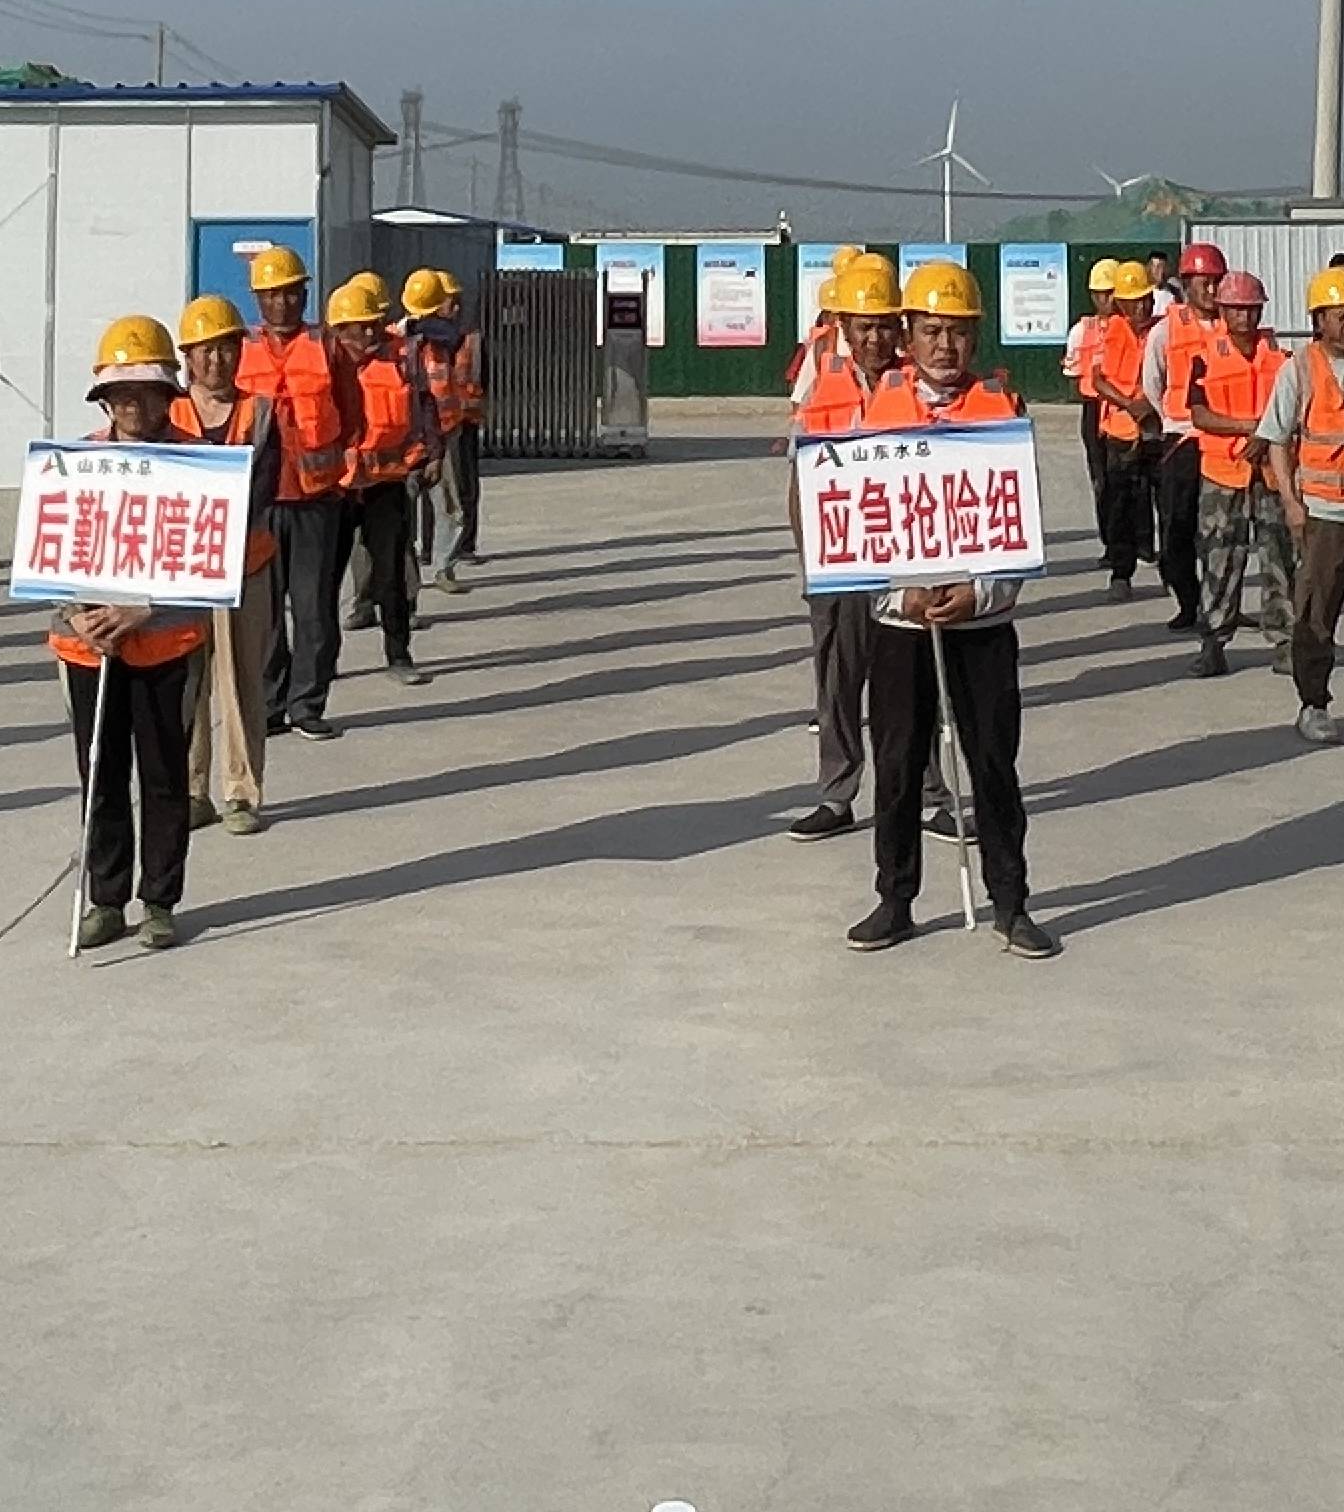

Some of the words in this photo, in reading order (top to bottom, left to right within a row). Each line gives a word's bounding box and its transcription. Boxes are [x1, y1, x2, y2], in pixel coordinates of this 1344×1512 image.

[29, 490, 230, 581] 后勤保障组
[817, 468, 1029, 568] 应急抢险组
